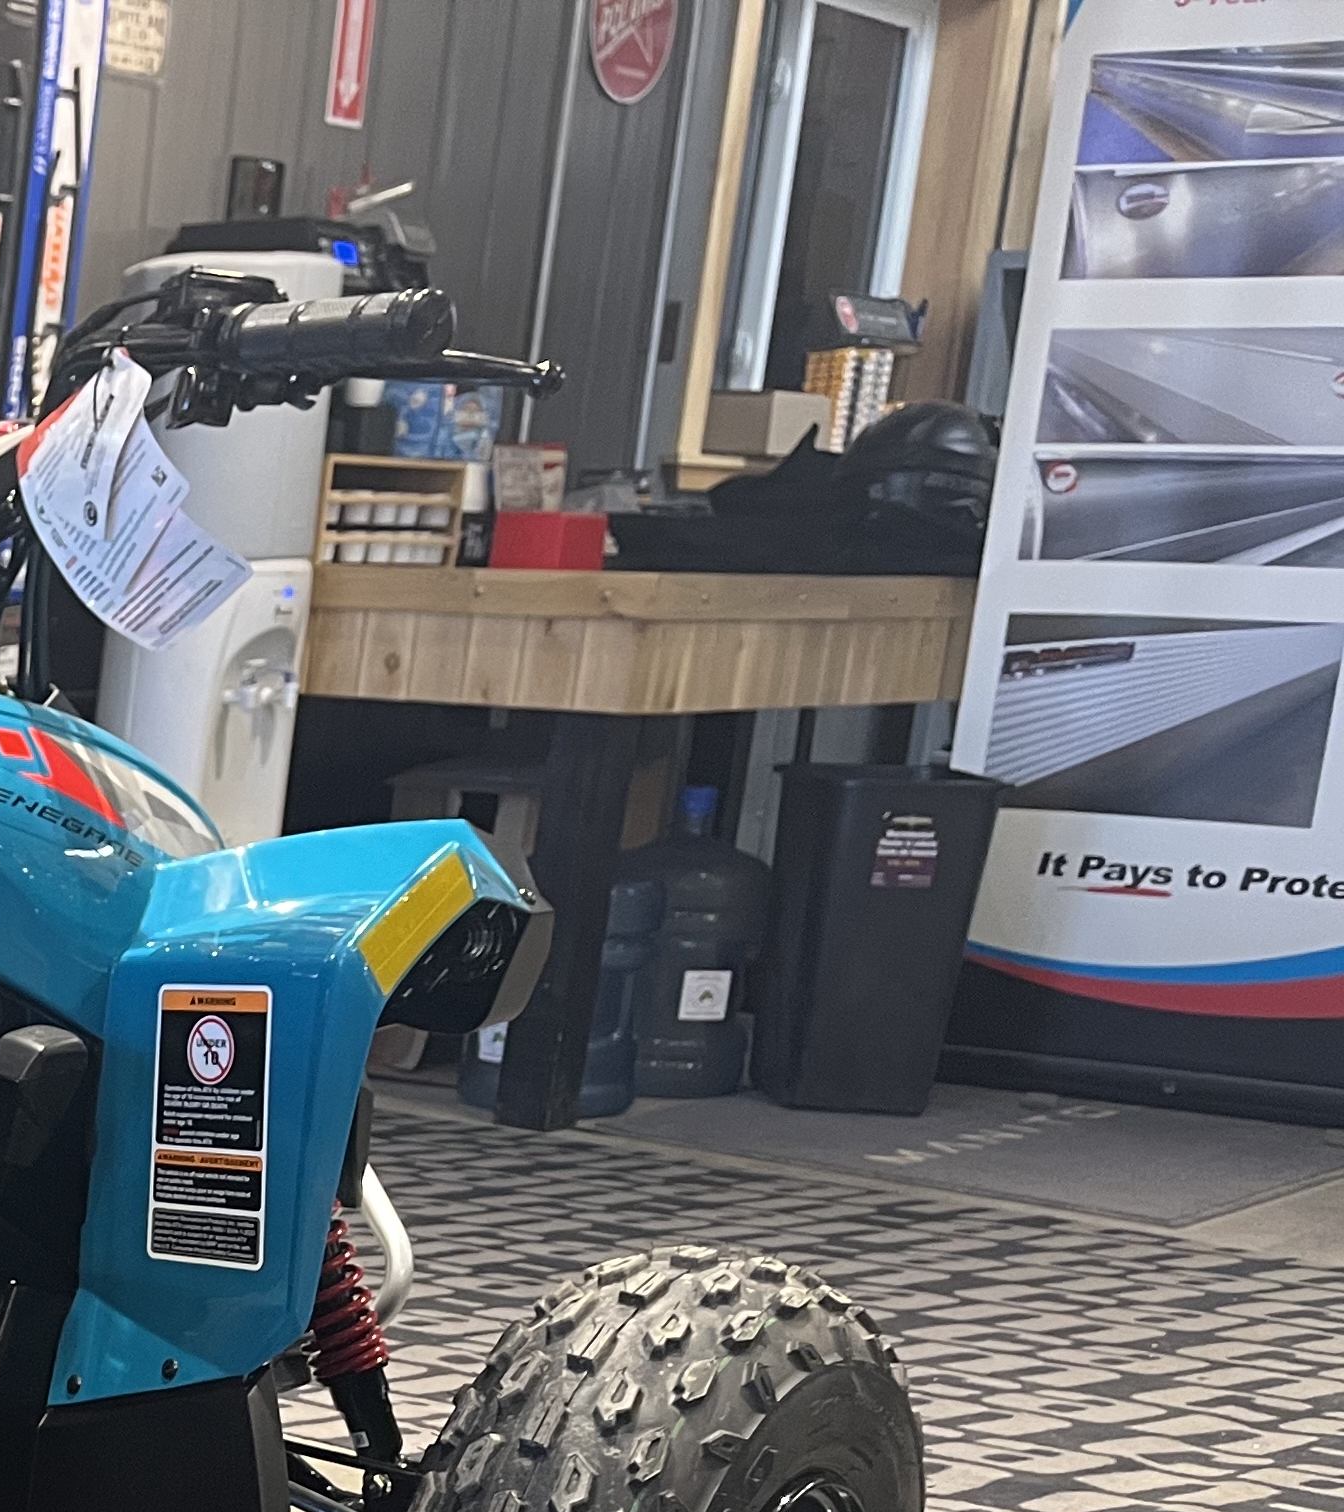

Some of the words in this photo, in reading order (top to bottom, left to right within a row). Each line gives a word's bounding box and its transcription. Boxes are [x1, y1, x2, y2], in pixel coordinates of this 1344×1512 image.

[1037, 851, 1068, 877] It
[1076, 854, 1174, 890] Pays
[1187, 864, 1227, 889] to
[1239, 867, 1344, 900] Prote
